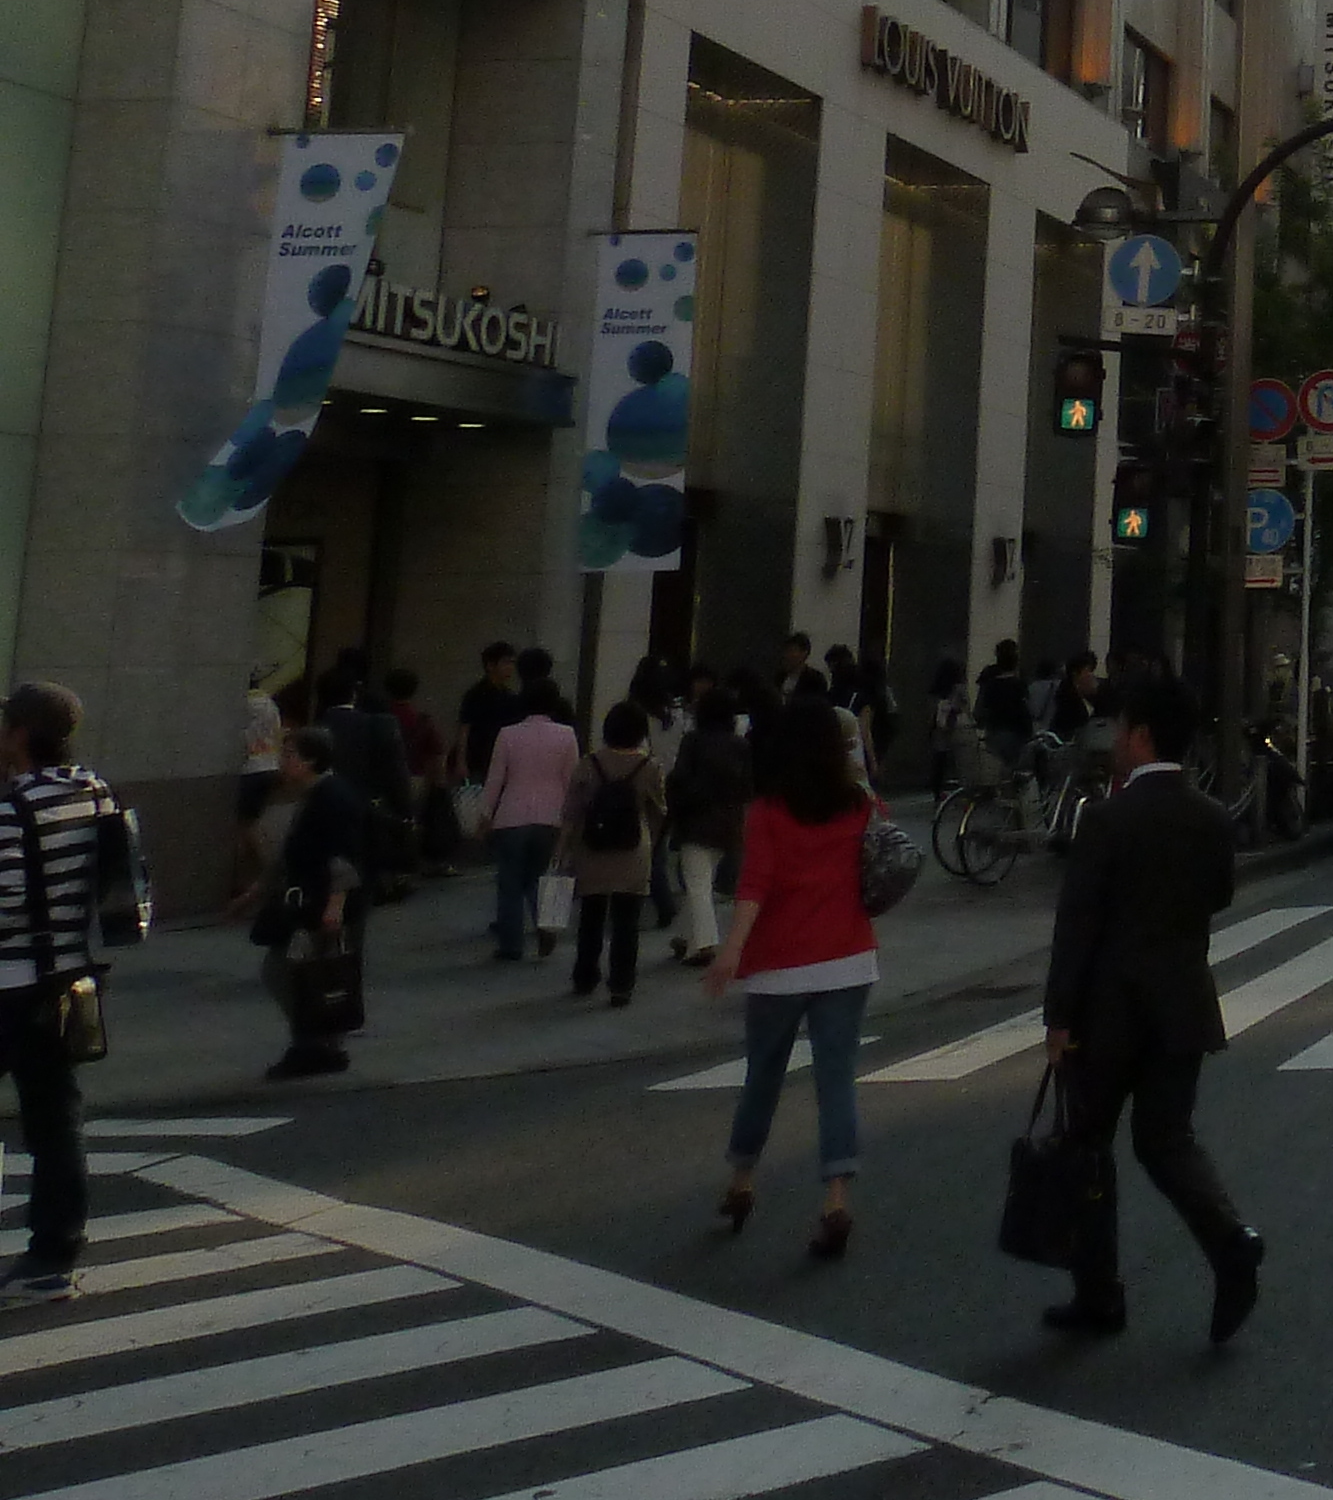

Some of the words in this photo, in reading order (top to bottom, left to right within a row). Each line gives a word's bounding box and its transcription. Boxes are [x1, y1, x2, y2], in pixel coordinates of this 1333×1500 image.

[862, 4, 939, 98] LOUIS
[946, 48, 1032, 154] VUITTON
[281, 223, 343, 240] Alcott
[278, 241, 357, 257] Summer
